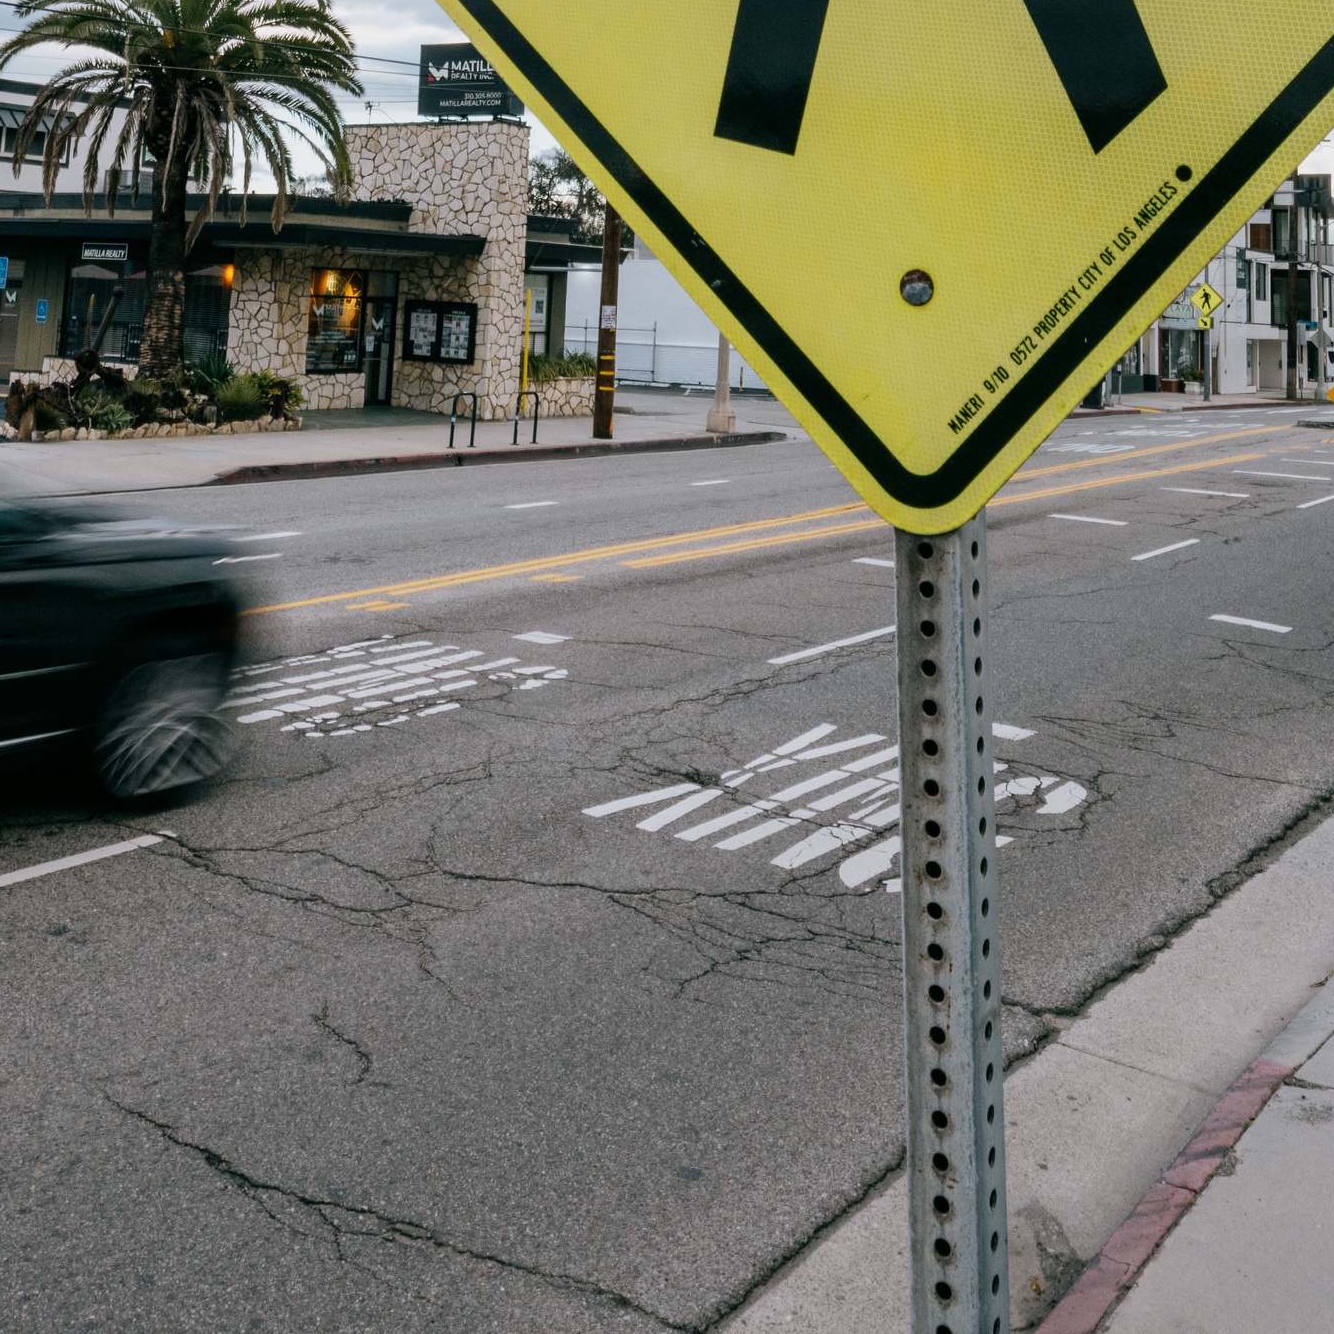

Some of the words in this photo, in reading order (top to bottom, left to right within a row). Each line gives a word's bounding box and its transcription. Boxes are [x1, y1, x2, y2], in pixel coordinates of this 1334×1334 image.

[452, 60, 496, 72] MATILL
[451, 72, 478, 80] REALTY
[84, 249, 105, 257] MATILLA
[106, 250, 125, 258] REALTY
[948, 394, 986, 435] MANERI
[984, 366, 1010, 394] 9/10
[1010, 336, 1038, 366] 0572
[1033, 286, 1081, 340] PROPERTY
[1078, 262, 1104, 291] CITY
[1099, 246, 1117, 266] OF
[1113, 226, 1137, 252] LOS
[1133, 181, 1178, 231] ANGELES
